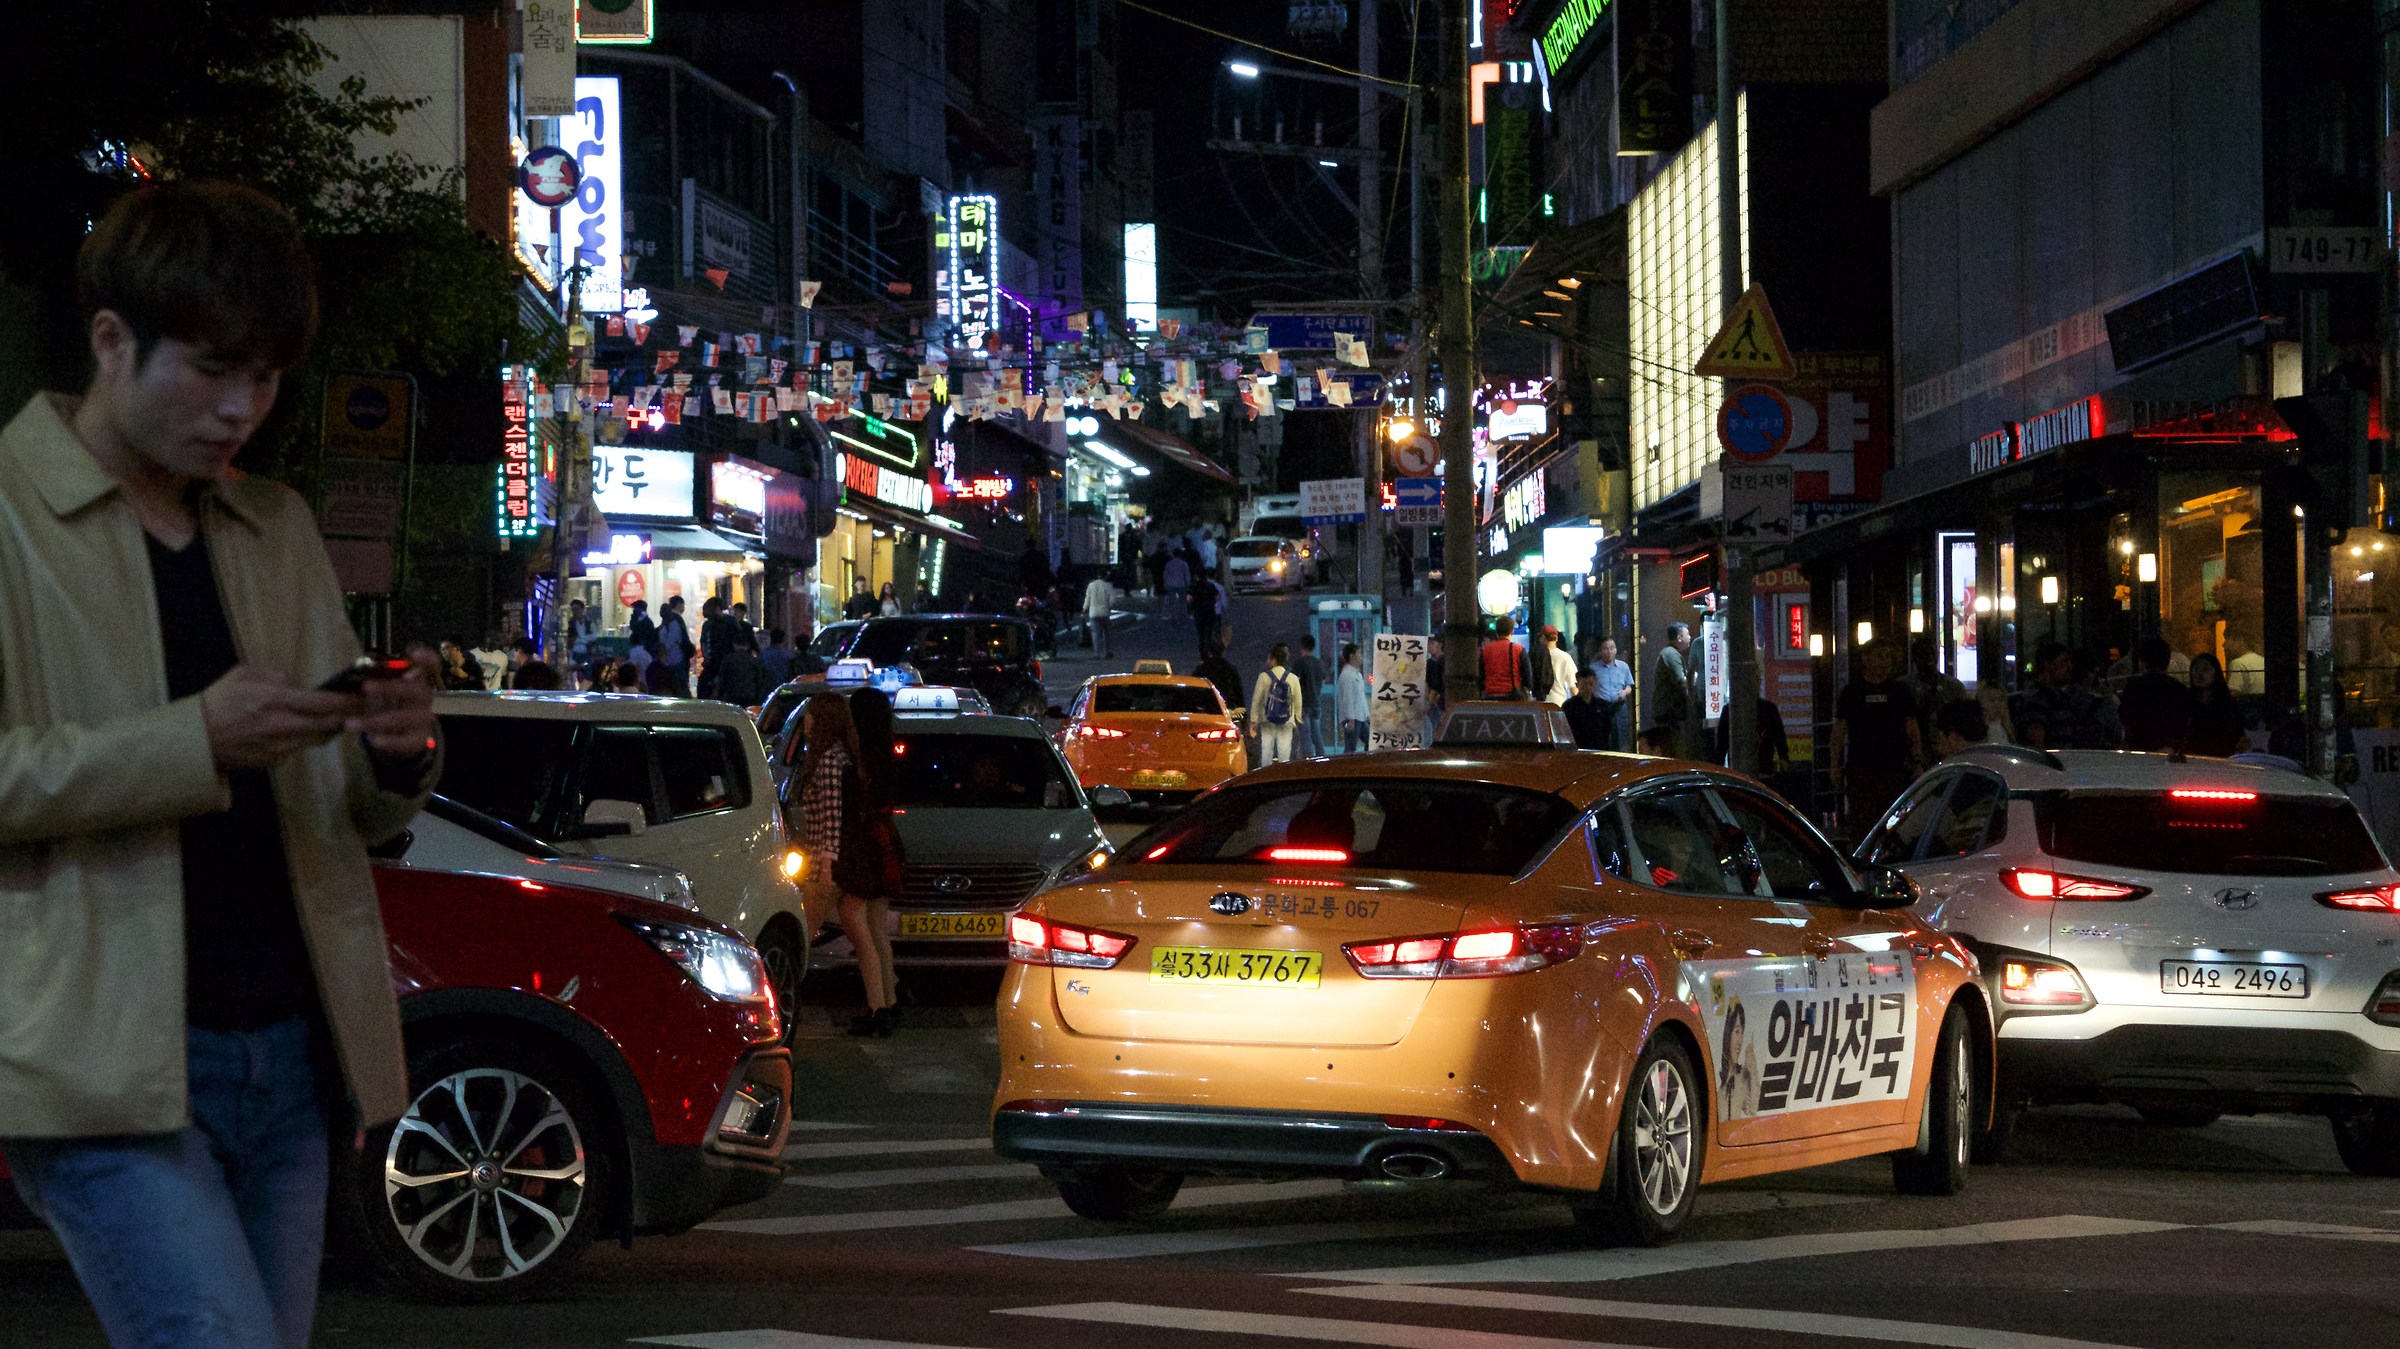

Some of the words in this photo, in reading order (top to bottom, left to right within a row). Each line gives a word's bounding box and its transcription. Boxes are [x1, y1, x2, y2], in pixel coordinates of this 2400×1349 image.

[960, 202, 988, 254] 테마
[2285, 236, 2371, 262] 749-77
[1970, 434, 2000, 475] PIZZA
[2020, 399, 2090, 458] REVOLUTION
[504, 397, 529, 518] 랜스젠더클럽
[956, 478, 1008, 498] 노래방
[511, 519, 527, 530] 2F
[1399, 508, 1439, 523] 일방통행
[1376, 636, 1425, 662] 맥주
[908, 694, 945, 708] 서울
[1378, 681, 1422, 706] 소주
[1460, 719, 1530, 739] TAXI
[1213, 896, 1245, 911] KIA
[1345, 901, 1380, 918] 067
[954, 917, 997, 933] 6469
[1237, 952, 1312, 983] 3767
[2175, 965, 2221, 990] 04오
[2234, 967, 2293, 992] 2496
[1757, 992, 1906, 1112] 알바천국
